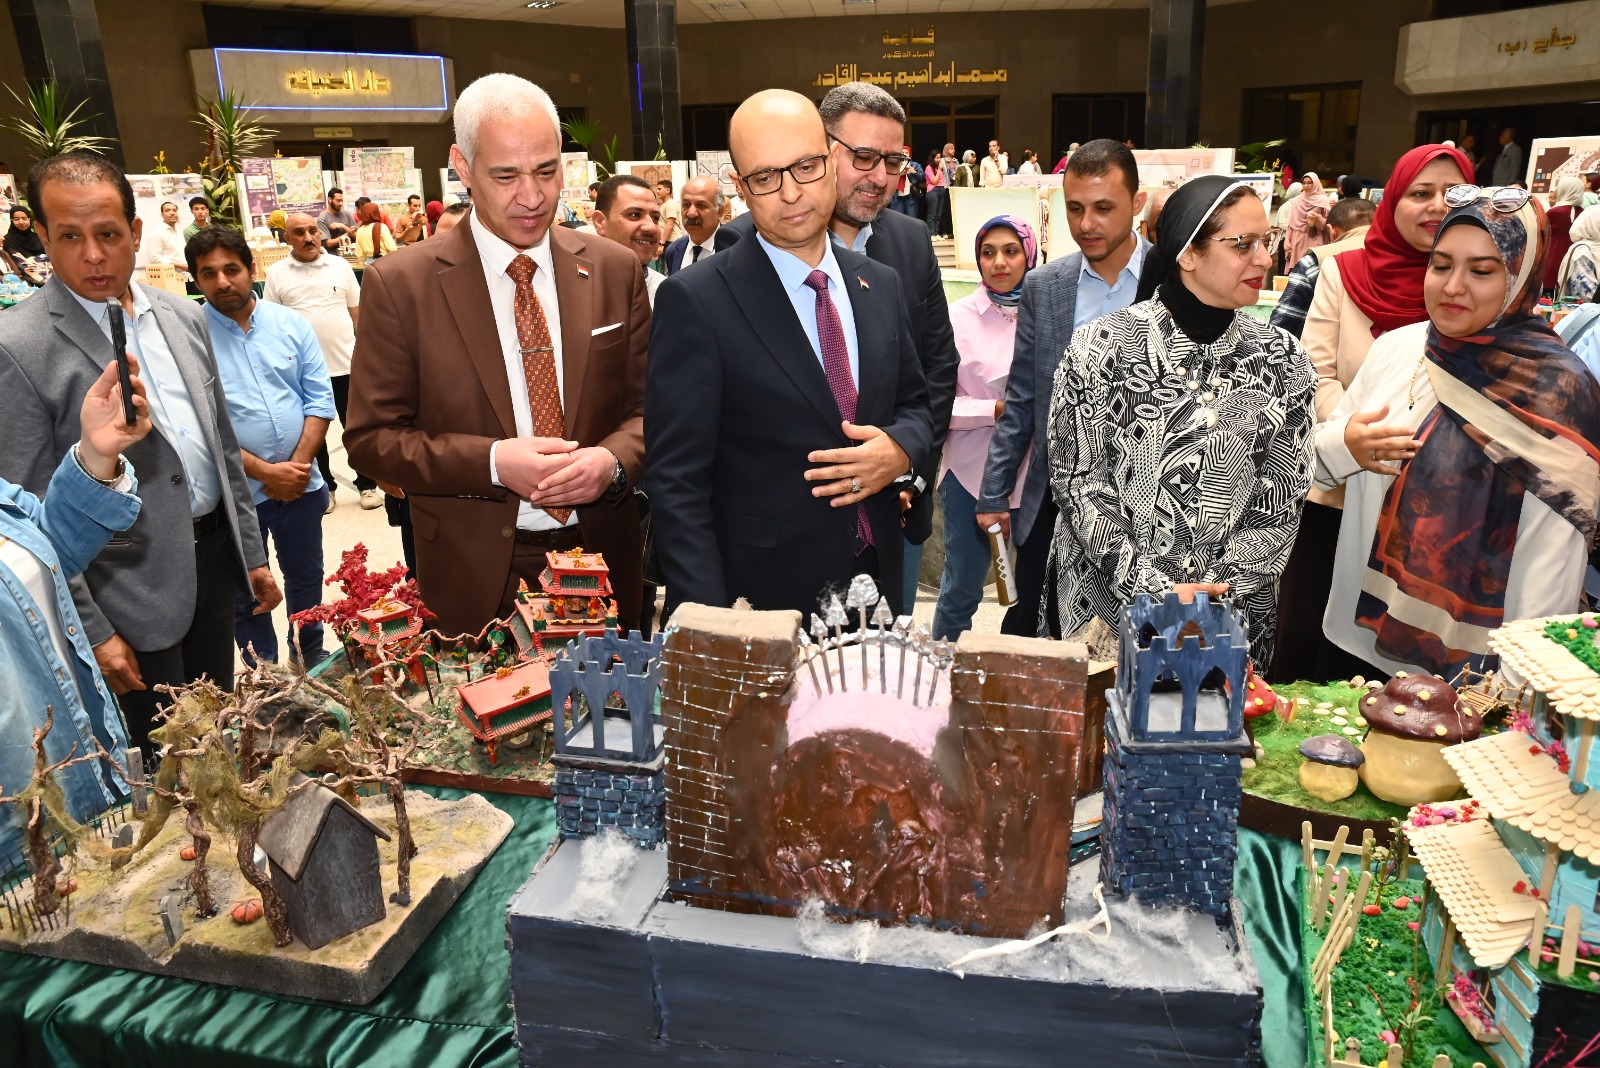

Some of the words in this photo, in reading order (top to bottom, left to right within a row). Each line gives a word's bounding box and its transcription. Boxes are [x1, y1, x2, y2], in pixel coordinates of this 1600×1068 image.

[882, 24, 935, 45] قاعة
[287, 69, 355, 95] الضيافة
[360, 69, 389, 92] دار
[812, 63, 857, 87] القادر
[860, 70, 893, 85] عبد
[894, 60, 955, 91] ابراهيم
[957, 69, 1008, 83] محمد
